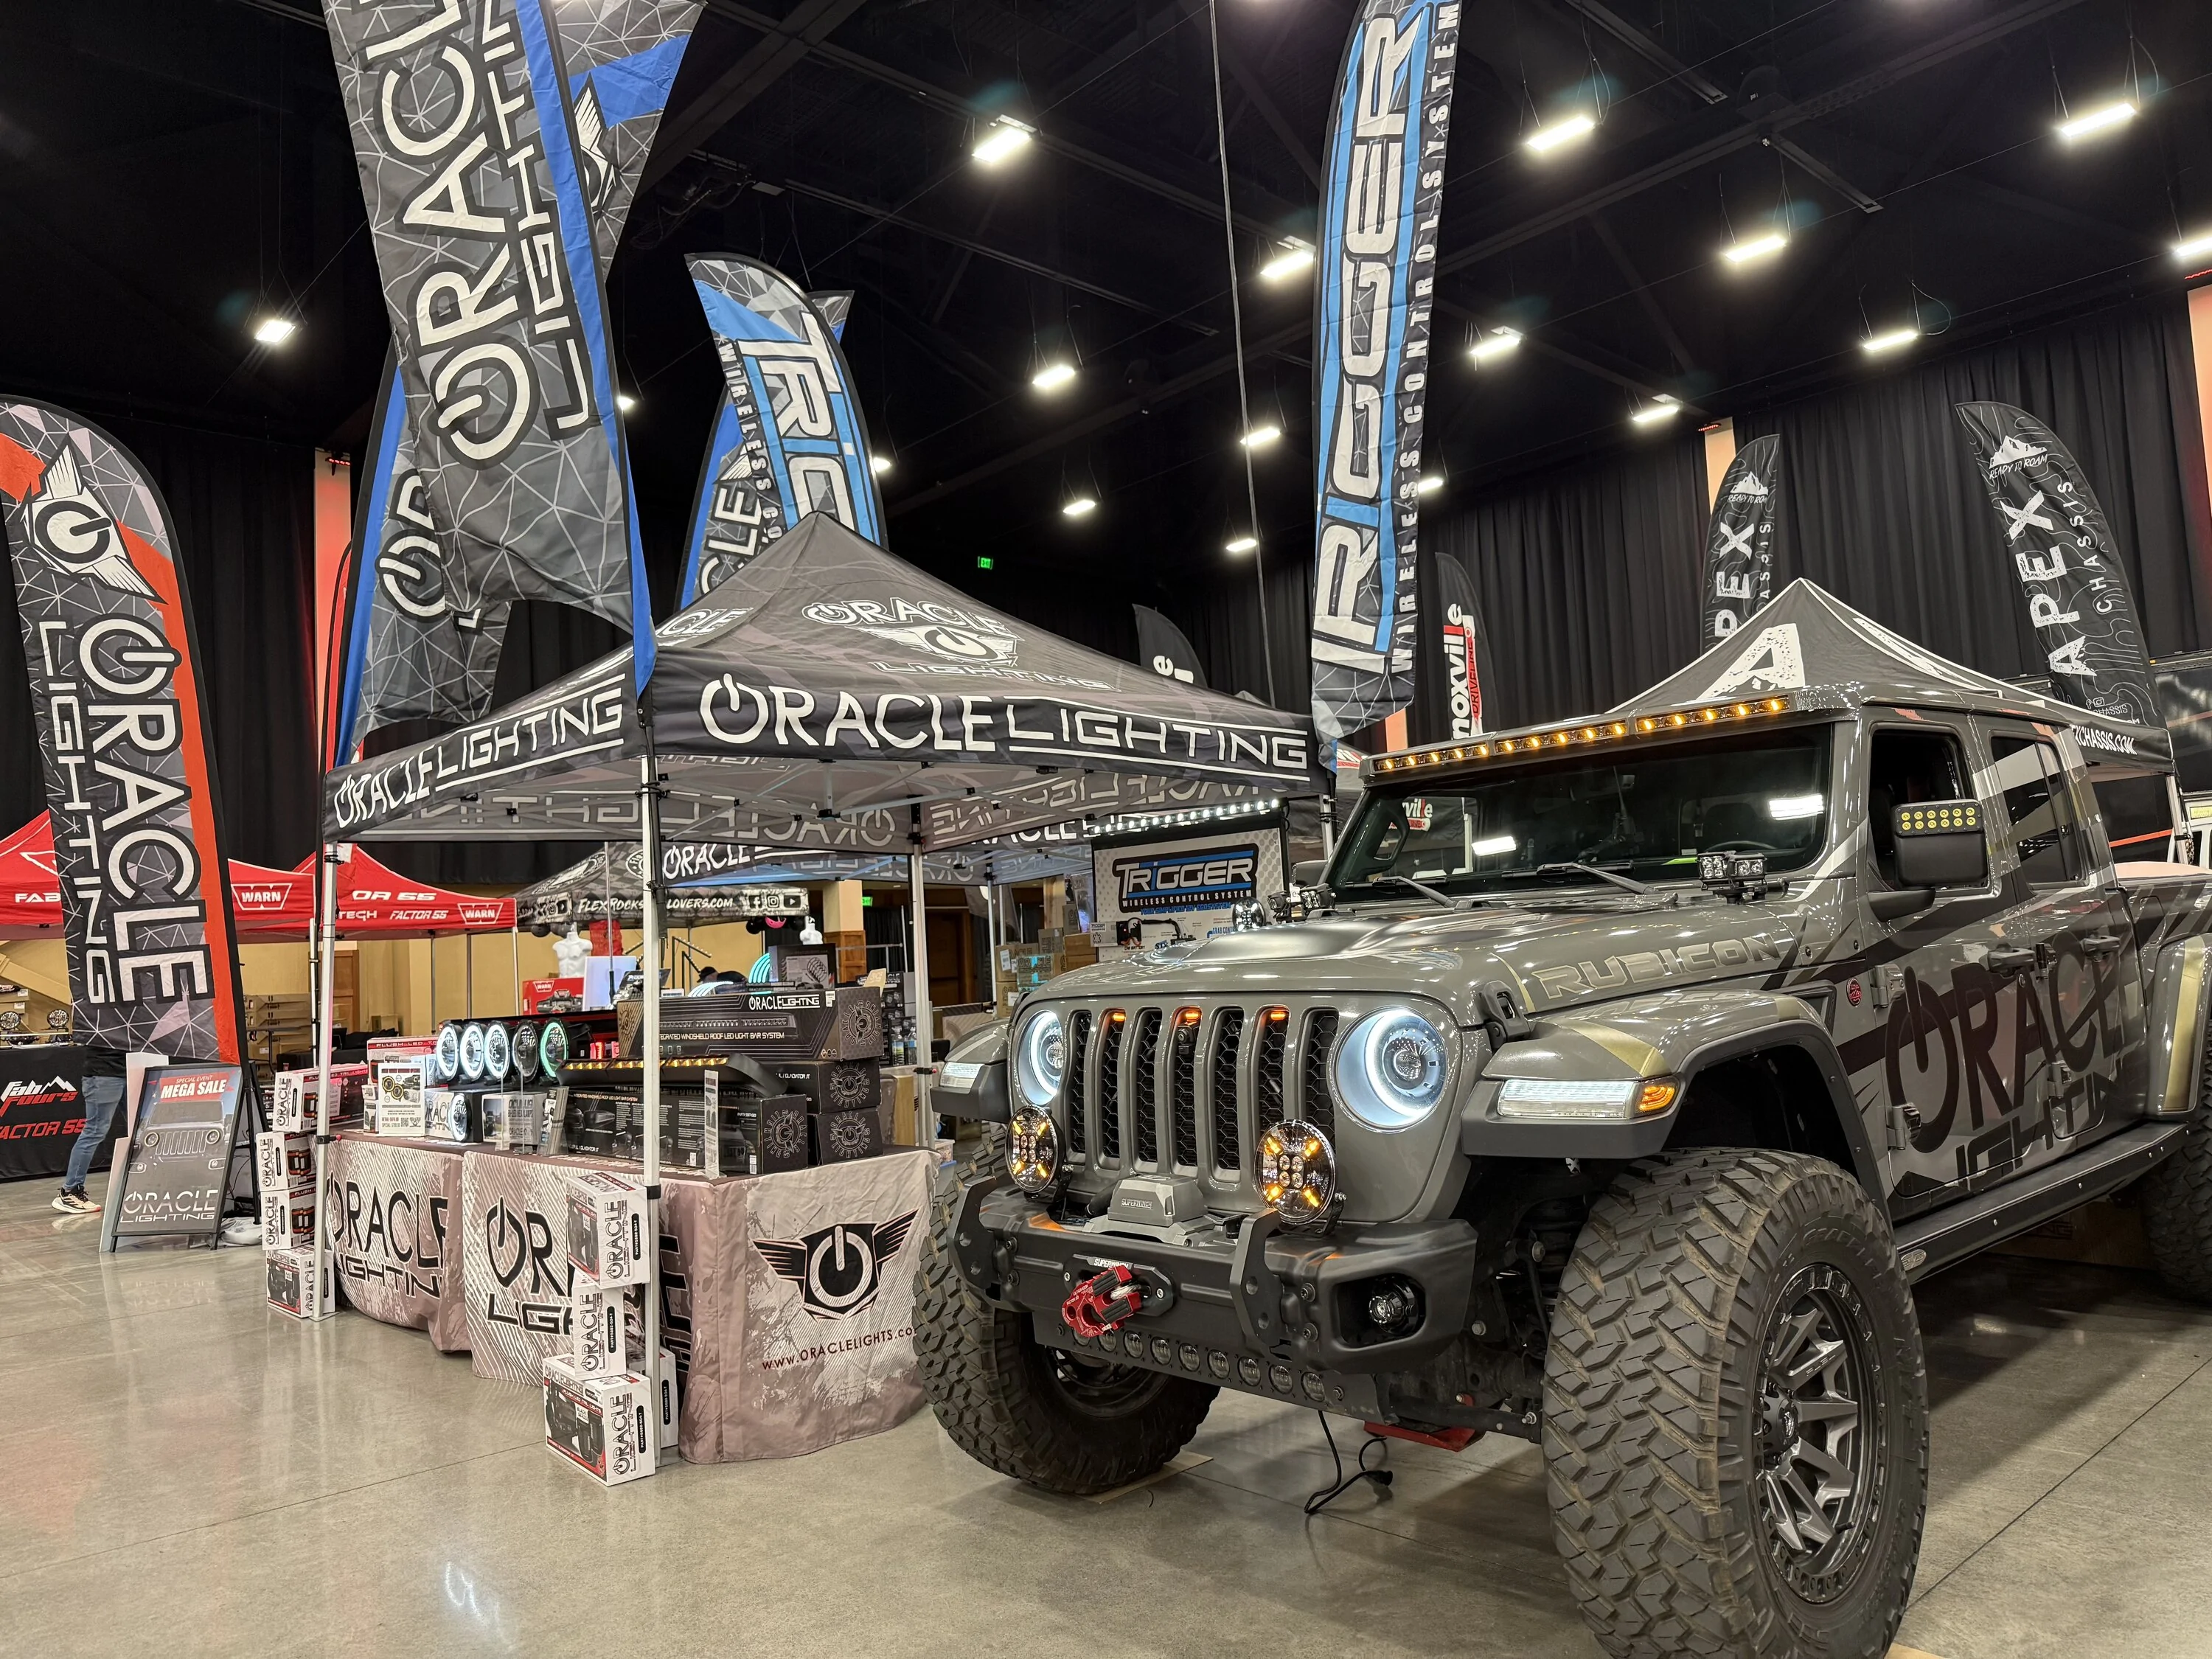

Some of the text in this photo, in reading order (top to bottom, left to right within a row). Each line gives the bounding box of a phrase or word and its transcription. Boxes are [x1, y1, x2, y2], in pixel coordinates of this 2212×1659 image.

[1422, 4, 1460, 189] SYSTEM
[1311, 11, 1422, 675] TRIGGER
[1391, 215, 1439, 674] WIRELESS CONTROL
[1989, 453, 2048, 479] READY TO ROAM
[2057, 481, 2112, 613] CHASSIS
[2000, 490, 2098, 677] APEX
[801, 598, 1021, 641] ORACLE
[699, 673, 1307, 770] ORACLE LIGHTING
[334, 687, 624, 829] ORACLE LIGHTING
[39, 621, 116, 1004] LIGHTING
[79, 618, 208, 1001] ORACLE
[664, 844, 751, 879] ORACLE
[1116, 859, 1253, 899] TRIGGER
[242, 891, 282, 902] WARN
[389, 910, 432, 920] FACTOR
[465, 909, 496, 919] WARN
[1122, 890, 1252, 907] WIRELESS CONTROL SYSTEM
[1531, 933, 1780, 999] RUBICON
[748, 995, 819, 1010] ORACLE LIGHTING
[762, 1032, 785, 1040] SYSTEM
[160, 1078, 226, 1099] MEGA SALE
[198, 1074, 213, 1082] EVENT
[276, 1077, 291, 1127] ORACLE
[0, 1121, 61, 1140] ACTOR
[262, 1138, 271, 1188] ORACLE
[119, 1211, 215, 1223] LIGHTING
[122, 1189, 219, 1214] ORACLE
[265, 1196, 276, 1246] ORACLE
[605, 1200, 624, 1279] ORACLE
[581, 1293, 599, 1371] ORACLE
[610, 1394, 630, 1475] ORACLE
